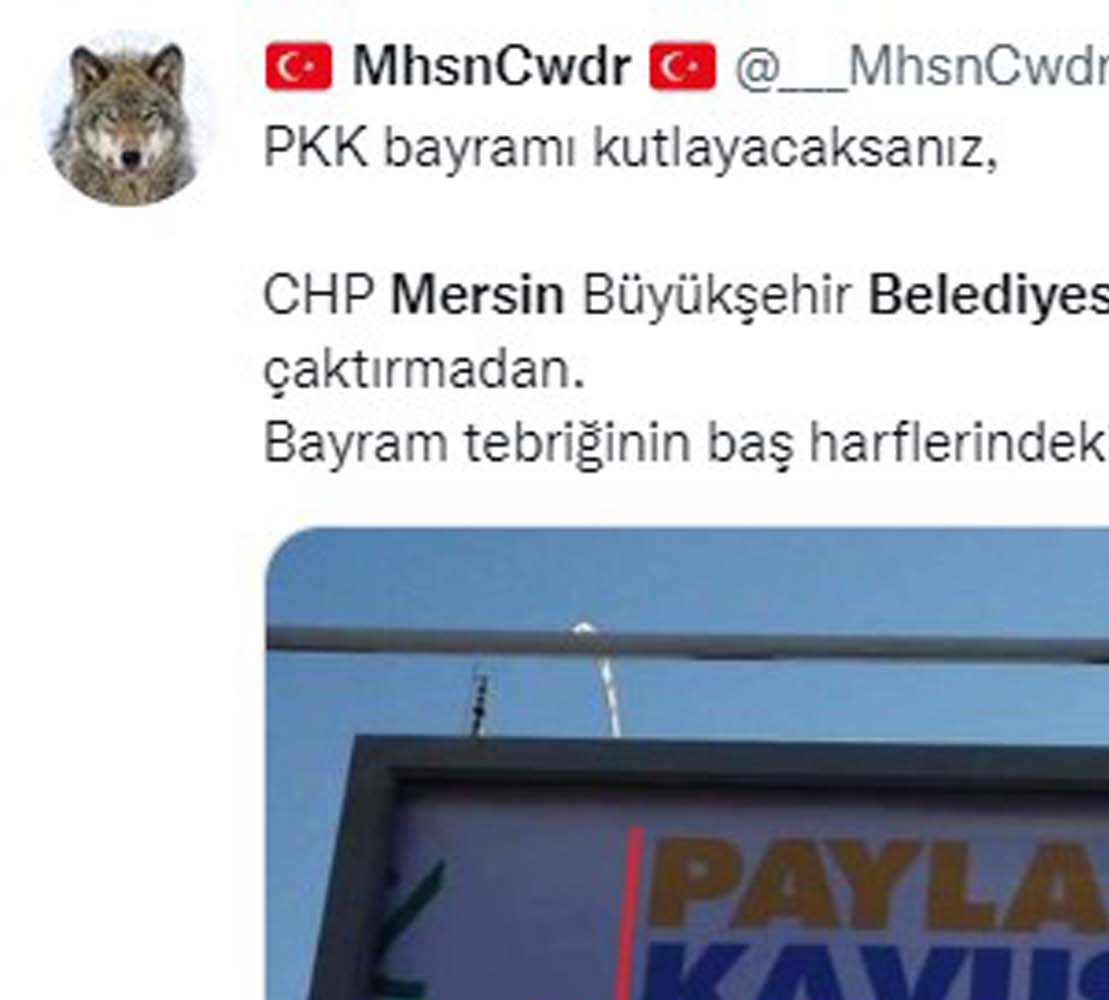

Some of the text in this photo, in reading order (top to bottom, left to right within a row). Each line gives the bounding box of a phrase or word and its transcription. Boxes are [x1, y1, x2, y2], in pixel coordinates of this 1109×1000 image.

[354, 43, 632, 86] MhsnCwdr
[265, 125, 997, 178] PKK bayramı kutlayacaksanız,
[264, 272, 374, 315] CHP
[392, 272, 563, 315] Mersin
[585, 272, 853, 326] Büyükşehir
[264, 347, 583, 399] çaktırmadan.
[266, 420, 447, 473] Bayram
[463, 420, 689, 473] tebriğinin
[709, 421, 794, 473] baş
